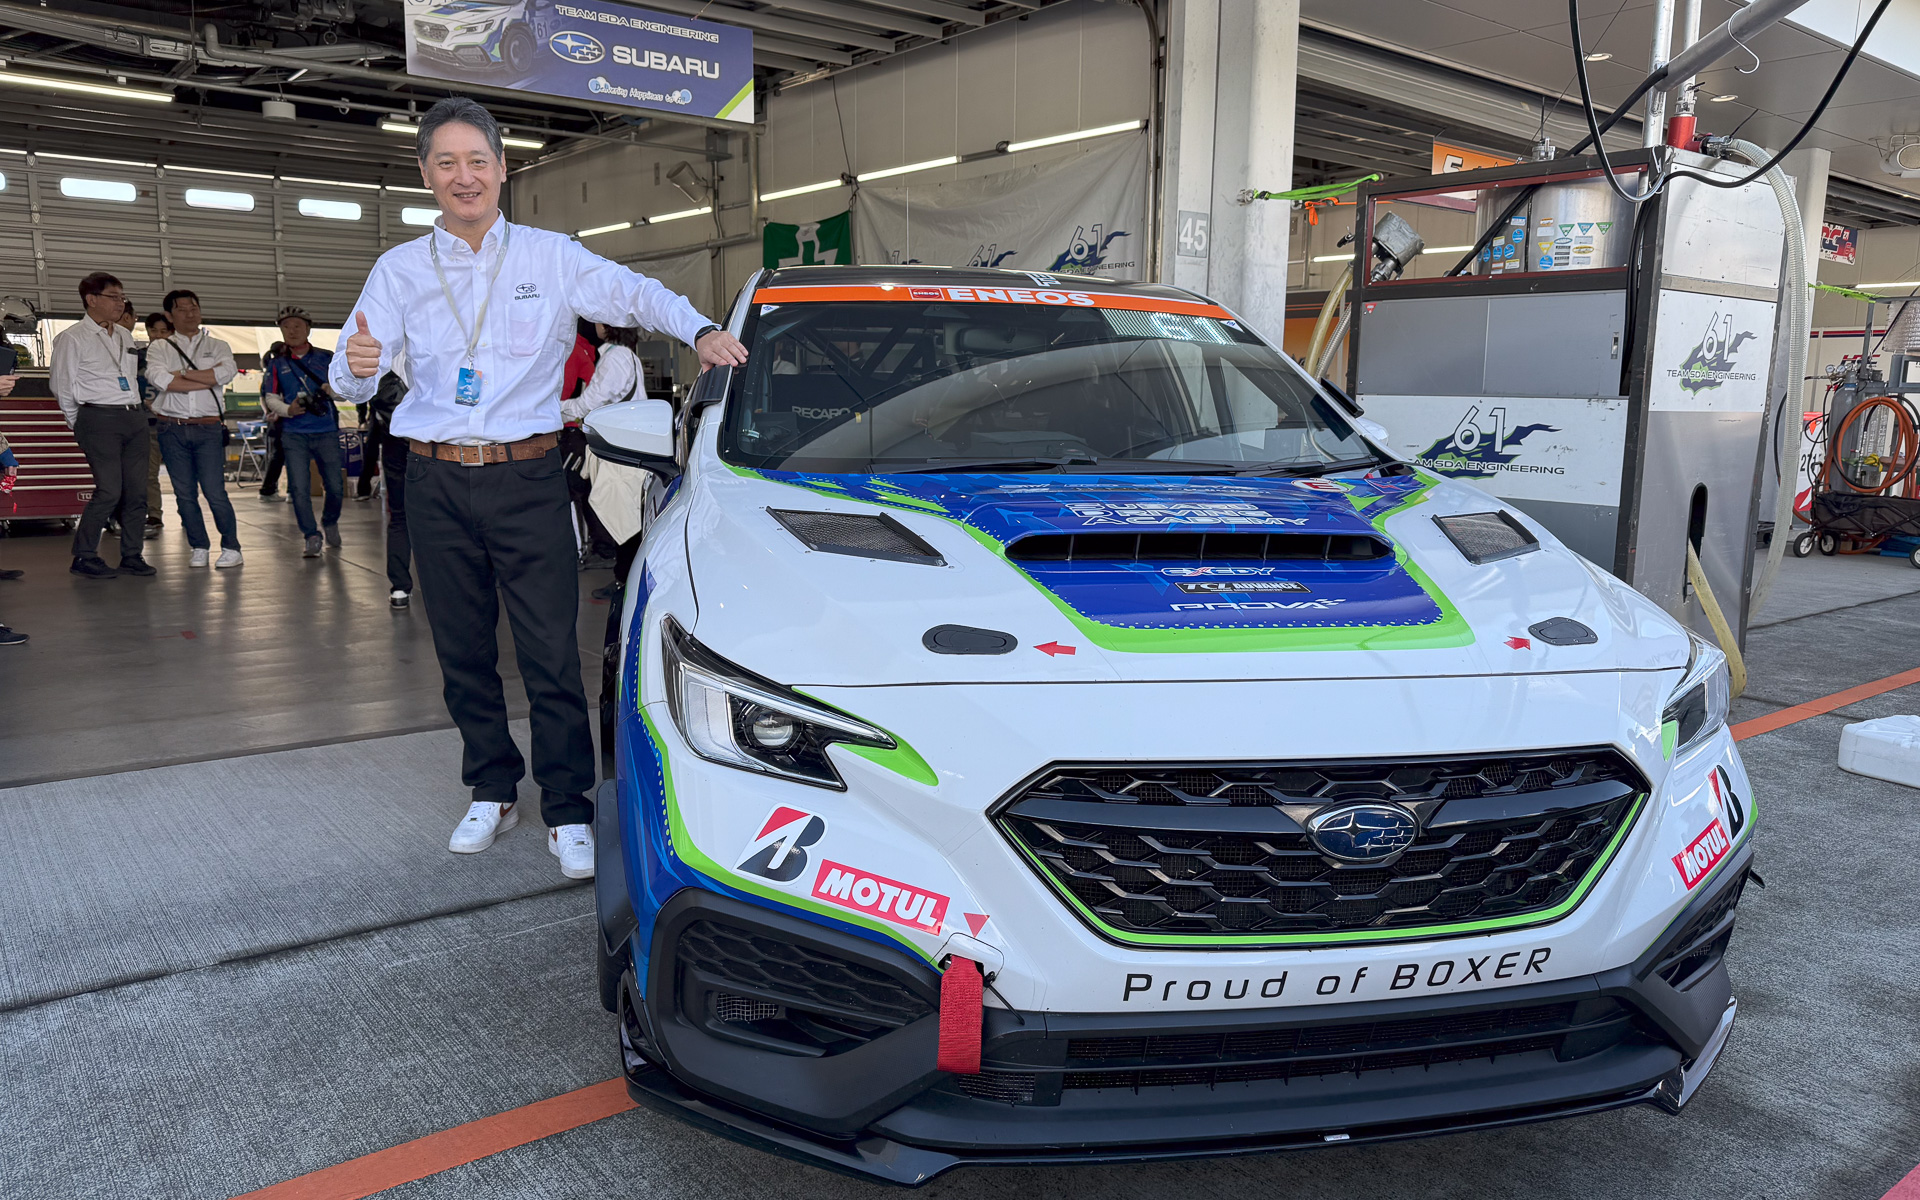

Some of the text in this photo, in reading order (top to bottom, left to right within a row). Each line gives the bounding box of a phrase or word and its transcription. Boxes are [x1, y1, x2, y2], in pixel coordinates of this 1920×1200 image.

[536, 21, 548, 38] 61
[555, 4, 719, 43] TEAM SDA ENGINEERING
[612, 45, 720, 79] SUBARU
[1069, 223, 1103, 260] 61
[1179, 217, 1207, 251] 45
[514, 293, 541, 301] SUBARU
[947, 288, 1095, 306] ENEOS
[1703, 311, 1733, 361] 61
[1666, 369, 1756, 381] TEAM SDA ENGINEERING
[1454, 405, 1506, 453] 61
[1435, 460, 1466, 469] SDA
[1467, 461, 1565, 475] ENGINEERING
[1065, 502, 1259, 511] SUBARU
[1072, 509, 1274, 518] DRIVING
[1082, 516, 1309, 526] ACADEMY
[1160, 566, 1276, 577] EXEDY
[1183, 582, 1232, 590] TCL
[1232, 582, 1302, 590] ADVANCE
[1170, 601, 1330, 611] PROVA
[1680, 824, 1728, 883] MOTUL
[818, 868, 938, 927] MOTUL
[1123, 947, 1552, 1001] Proud of BOXER
